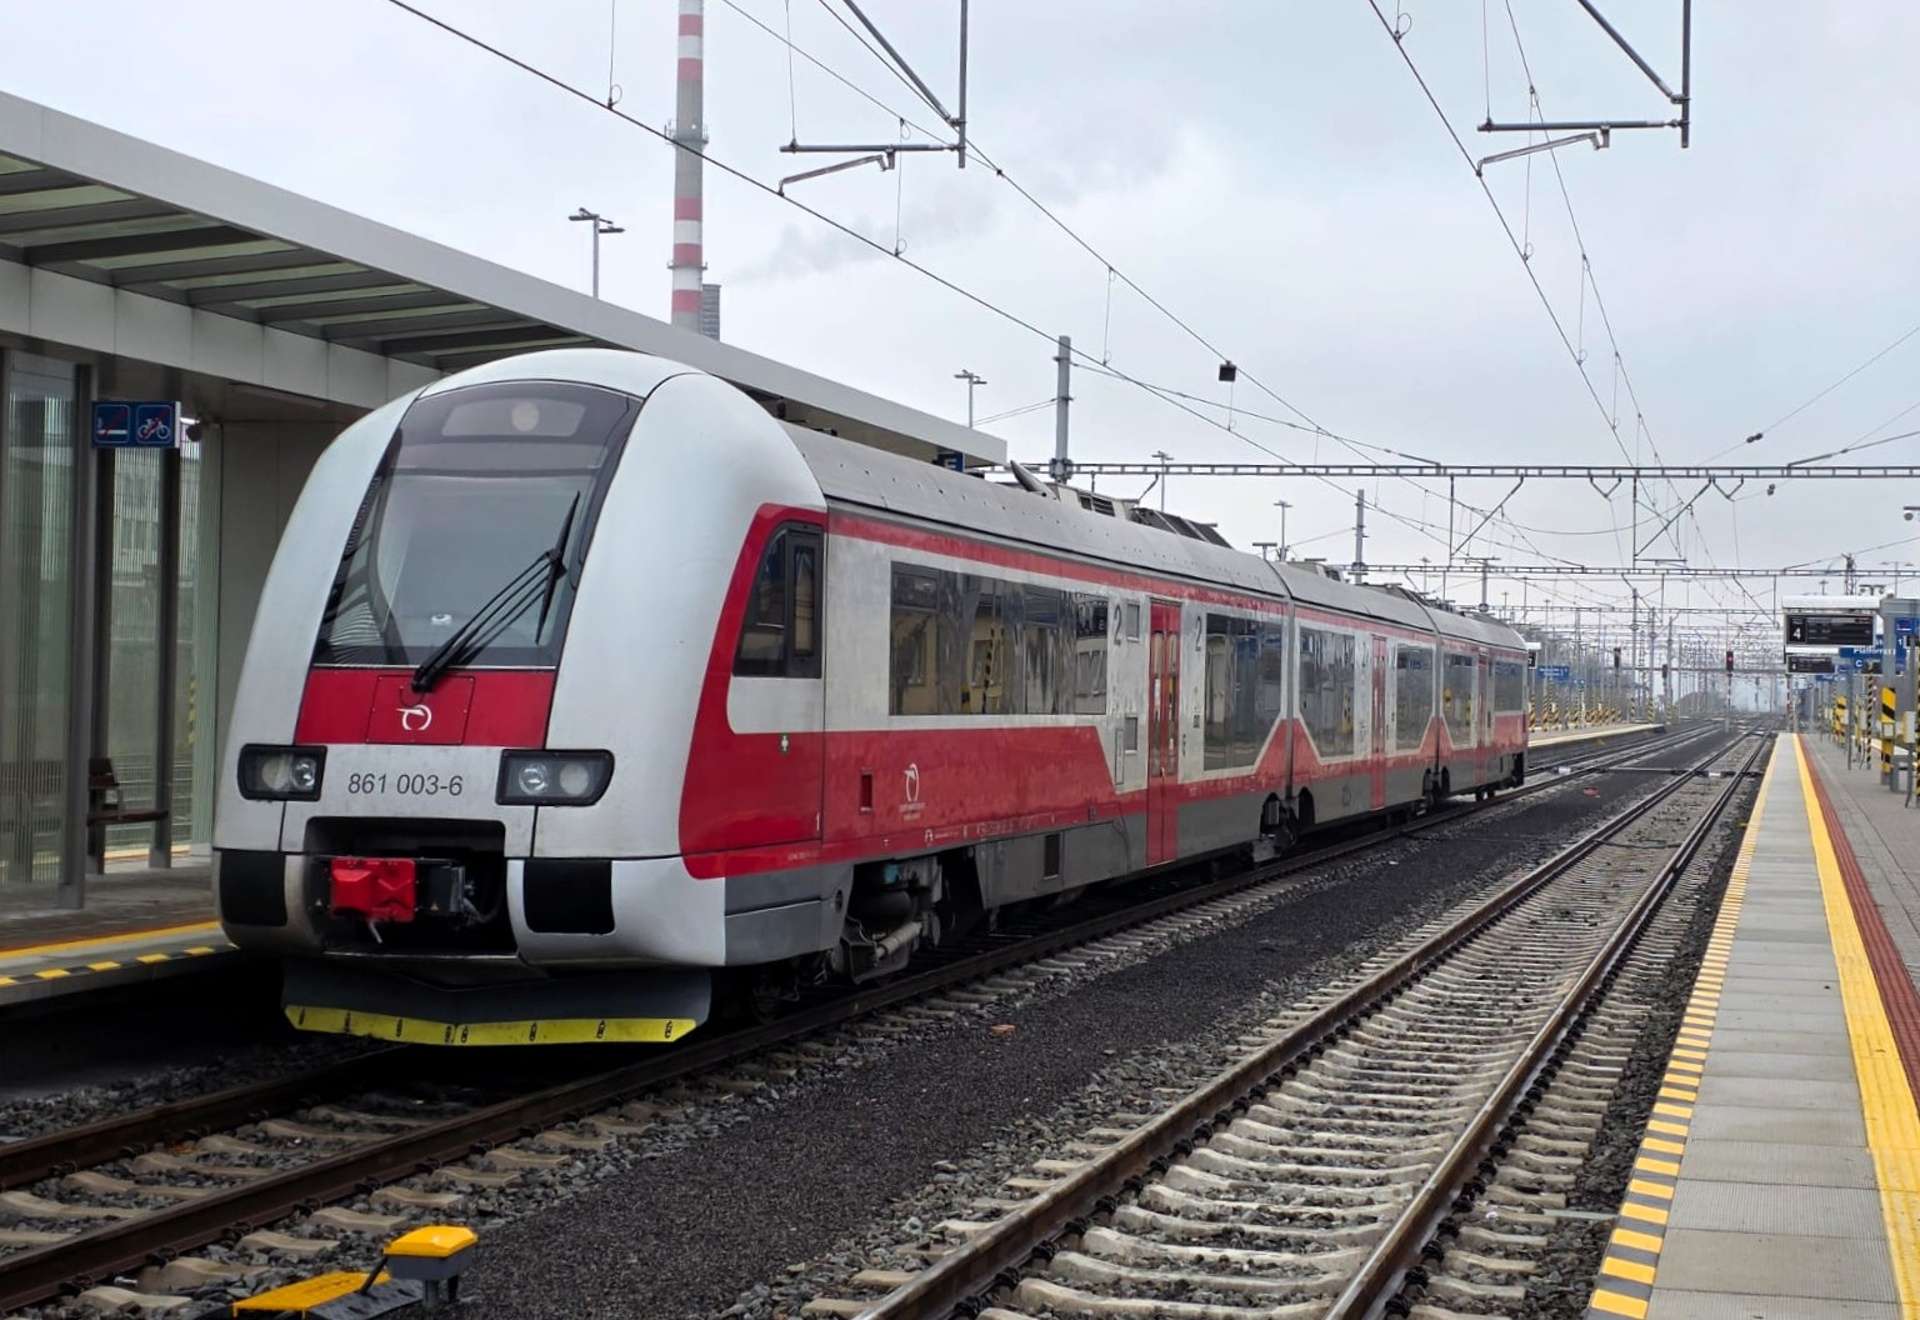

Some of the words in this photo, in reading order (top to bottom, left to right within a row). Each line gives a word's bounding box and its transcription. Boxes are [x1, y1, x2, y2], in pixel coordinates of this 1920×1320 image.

[1113, 604, 1123, 646] 2
[1195, 615, 1203, 652] 2
[348, 772, 386, 794] 861
[396, 774, 463, 796] 003-6
